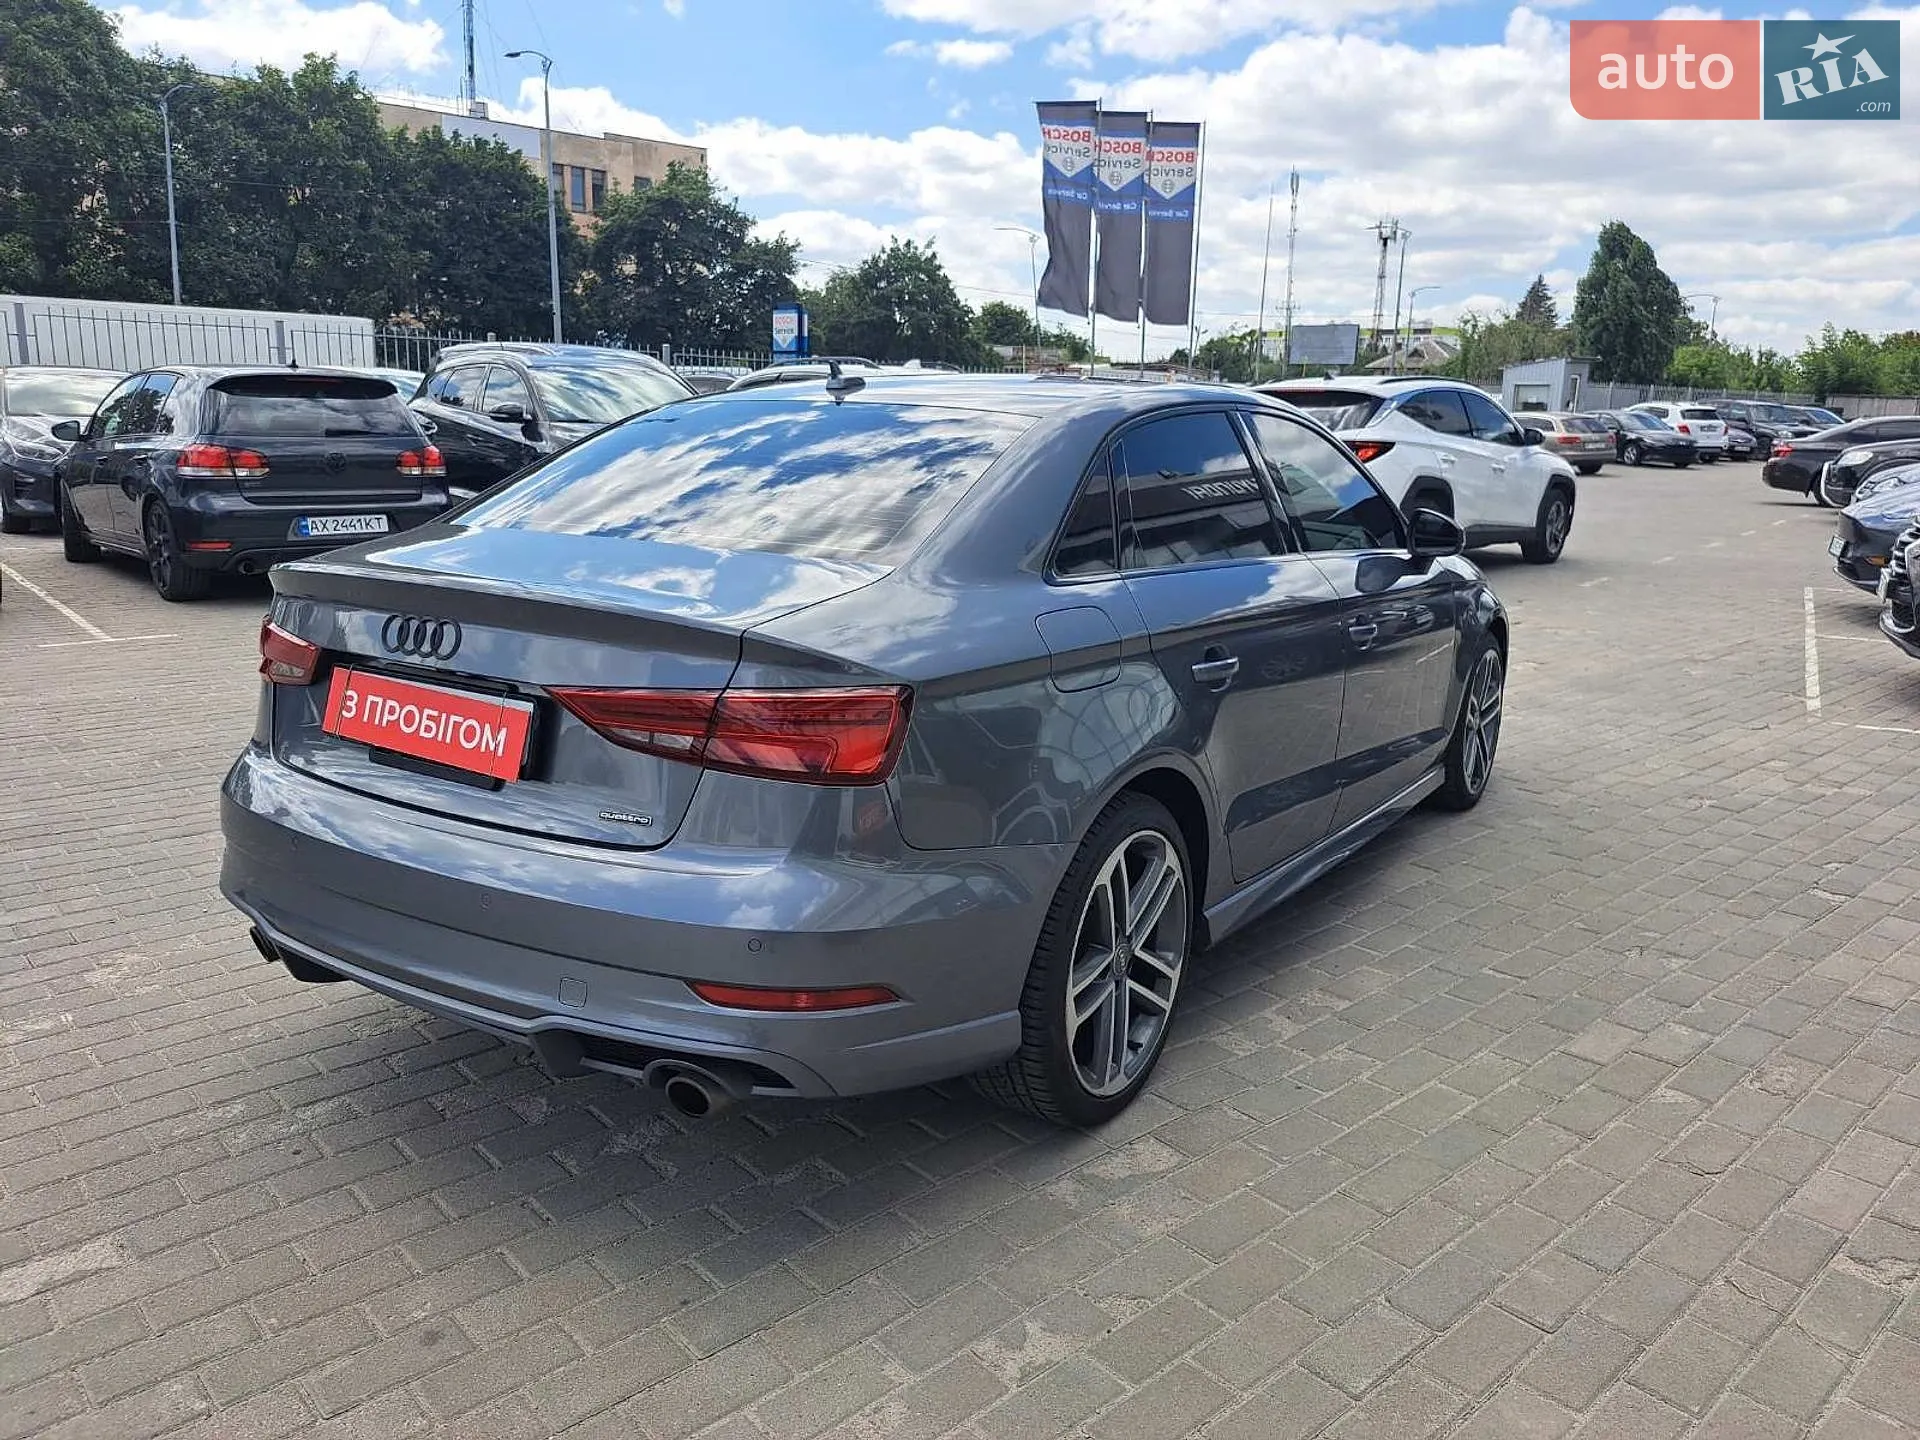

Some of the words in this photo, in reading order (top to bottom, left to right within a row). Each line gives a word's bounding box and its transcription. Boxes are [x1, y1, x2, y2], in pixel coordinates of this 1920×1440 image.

[310, 519, 330, 533] AX
[341, 690, 358, 719] З
[363, 695, 508, 757] ПРОБІГОМ
[599, 811, 650, 824] quattro
